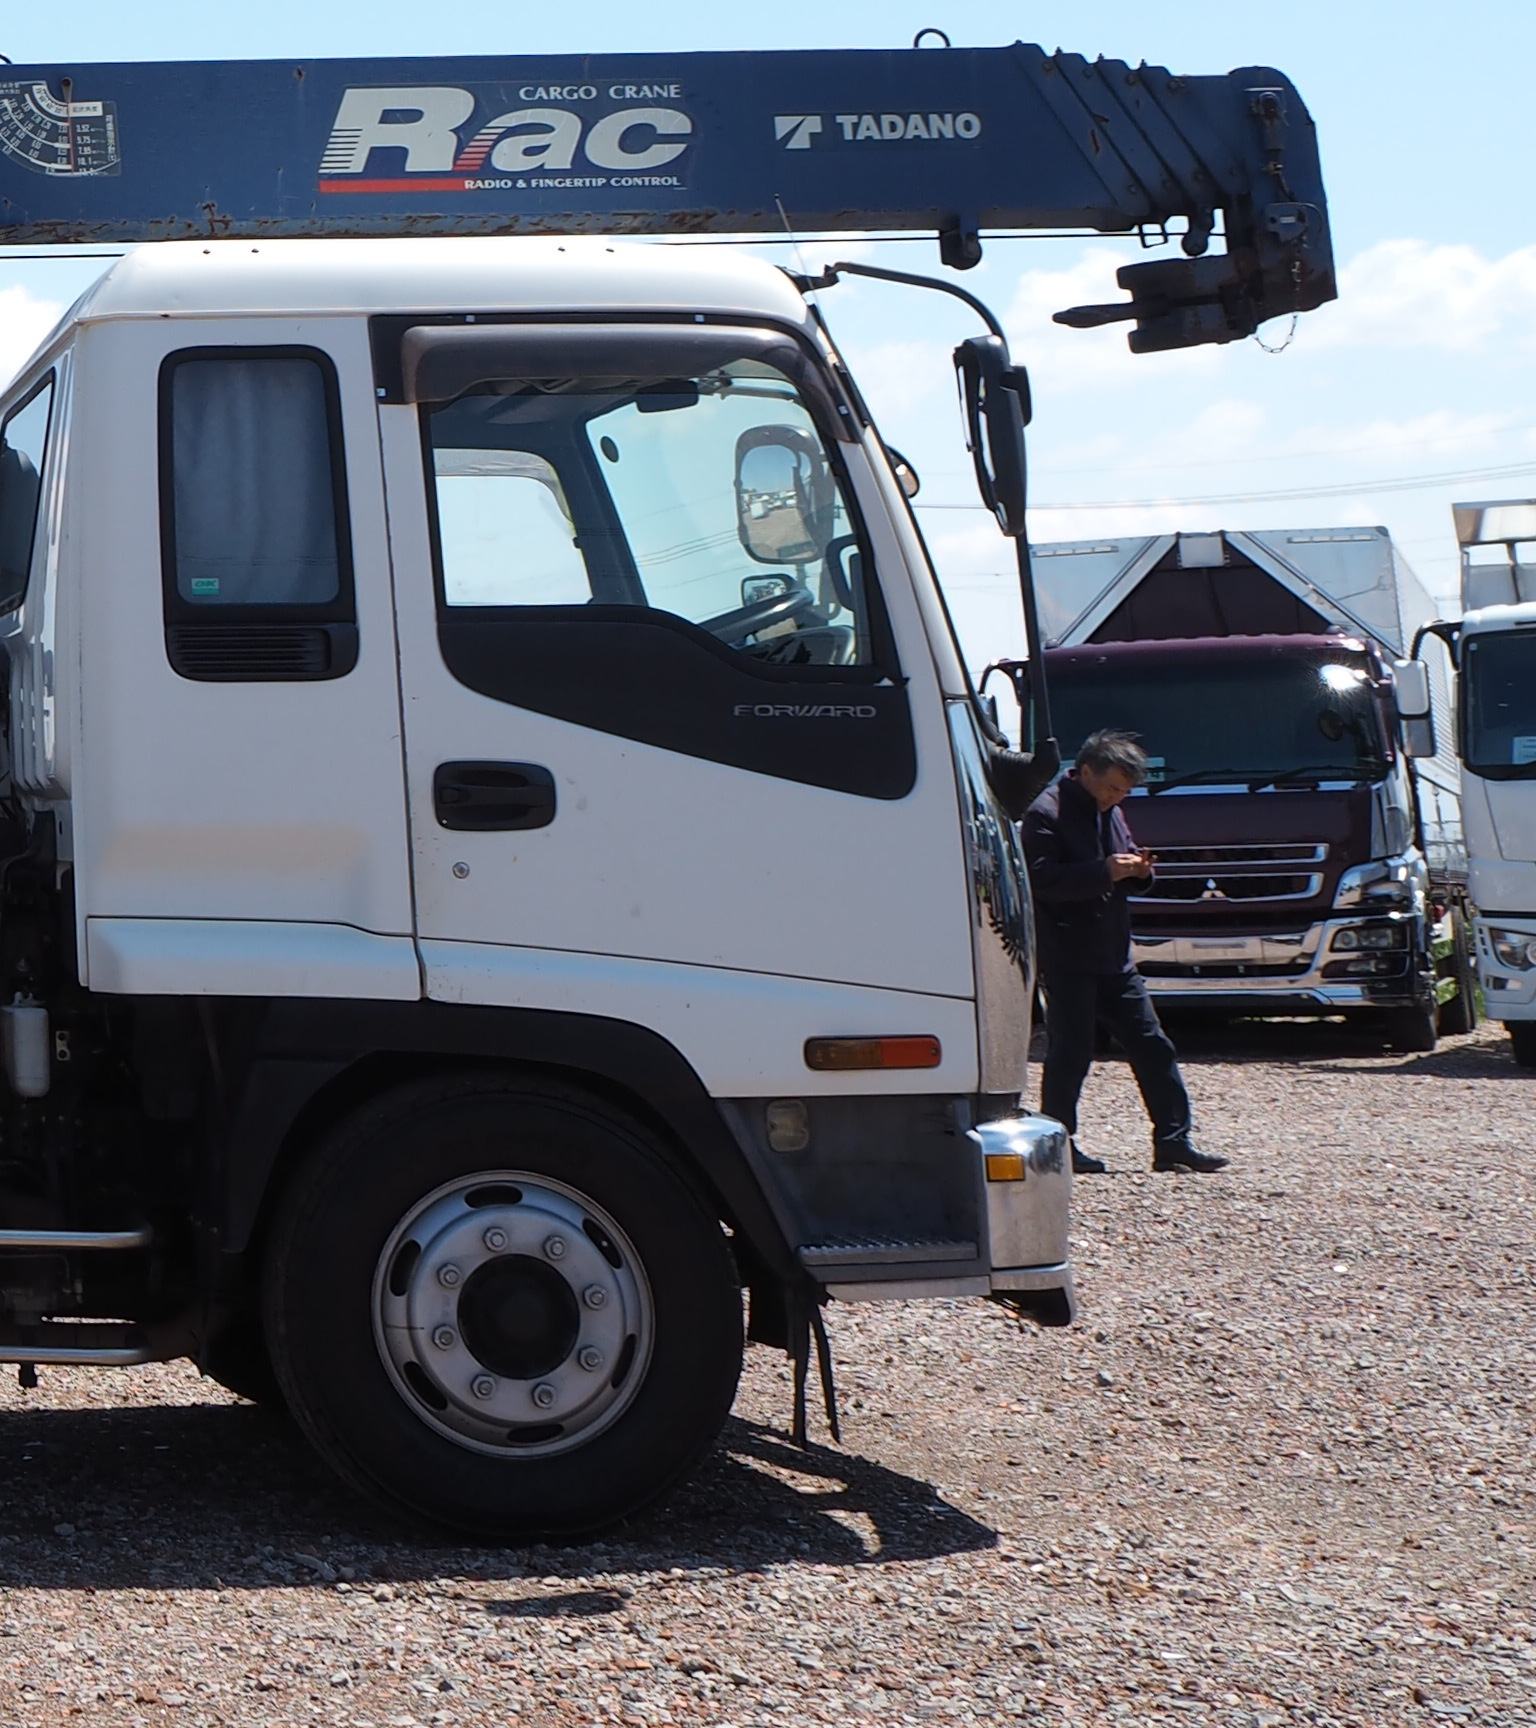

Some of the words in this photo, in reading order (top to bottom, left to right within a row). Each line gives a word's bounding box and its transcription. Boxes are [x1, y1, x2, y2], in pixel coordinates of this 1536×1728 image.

[519, 86, 597, 100] CARGO
[609, 85, 681, 99] CRANE
[835, 113, 981, 140] TADANO
[464, 179, 512, 190] RADIO
[516, 178, 527, 188] &
[531, 177, 607, 188] FINGERTIP
[610, 176, 681, 187] CONTROL
[733, 704, 877, 718] FORWARD
